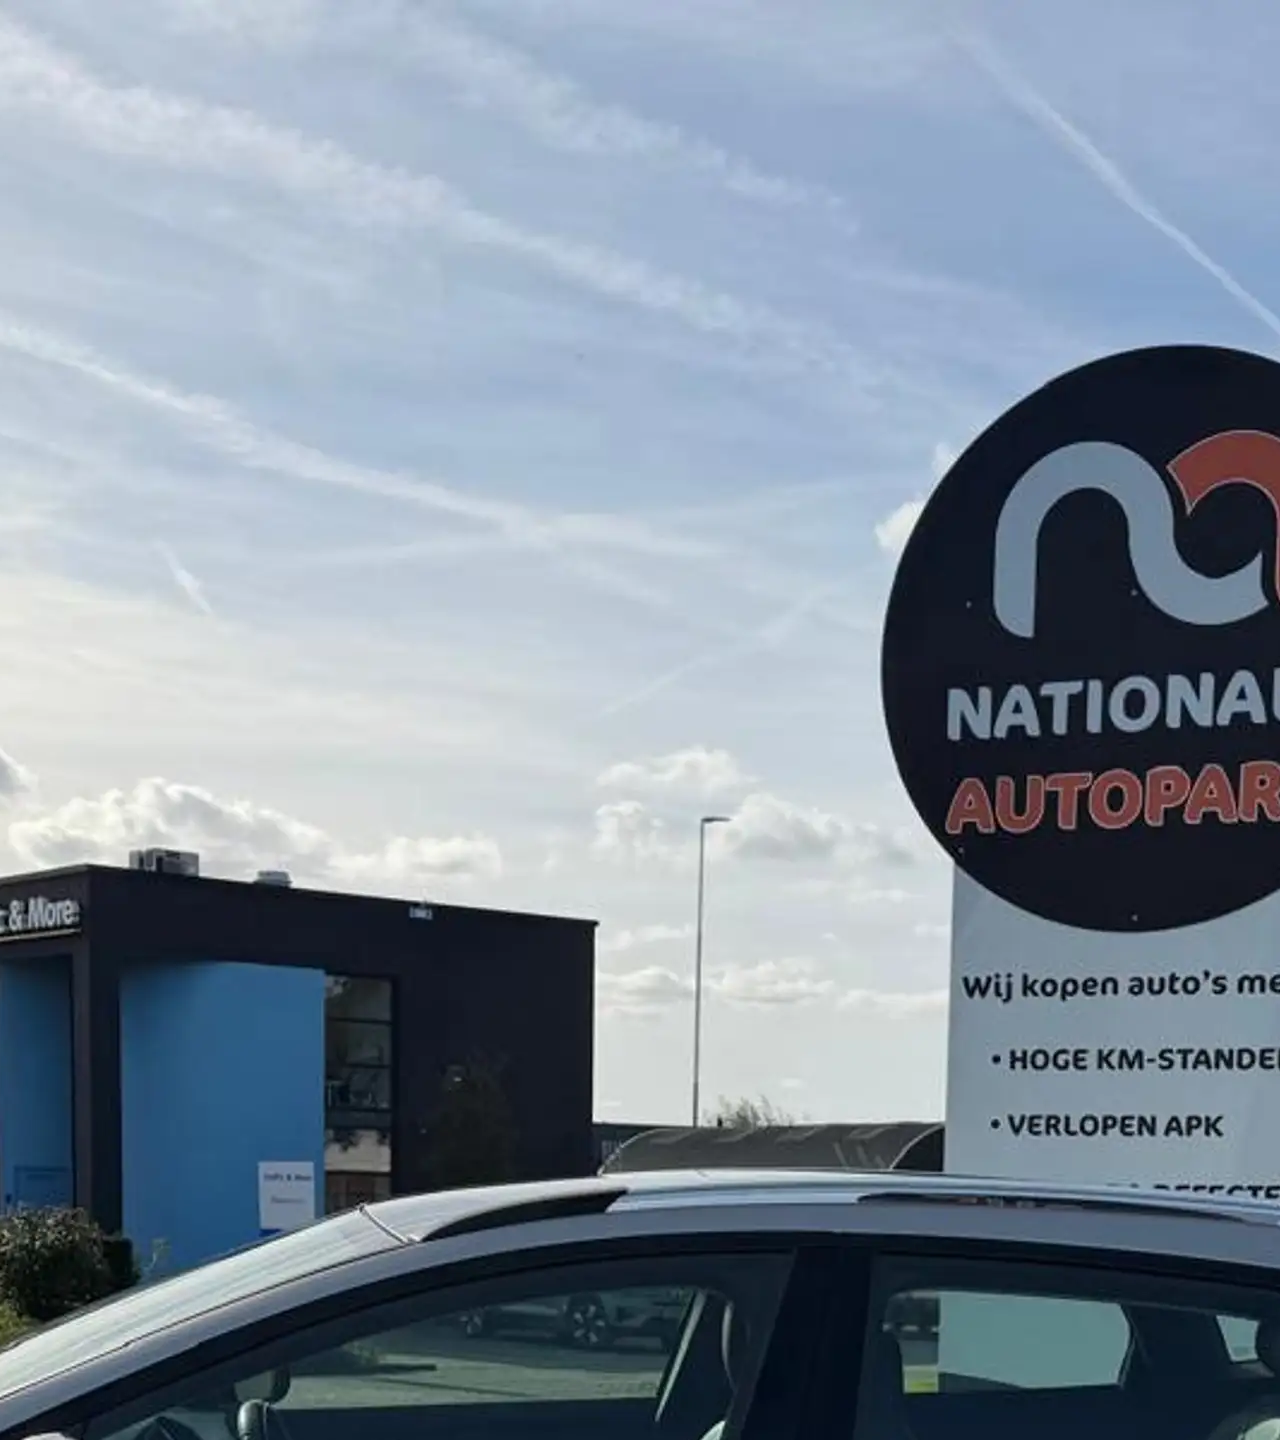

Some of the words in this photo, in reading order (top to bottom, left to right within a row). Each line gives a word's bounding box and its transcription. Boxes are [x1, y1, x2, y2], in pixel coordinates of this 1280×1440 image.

[8, 899, 26, 932] &
[27, 896, 80, 929] More
[962, 973, 1014, 1004] Wij
[1022, 973, 1119, 1002] kopen
[1127, 970, 1227, 997] auto's
[1009, 1048, 1088, 1071] HOGE
[1007, 1115, 1156, 1137] VERLOPEN
[1164, 1115, 1225, 1138] APK
